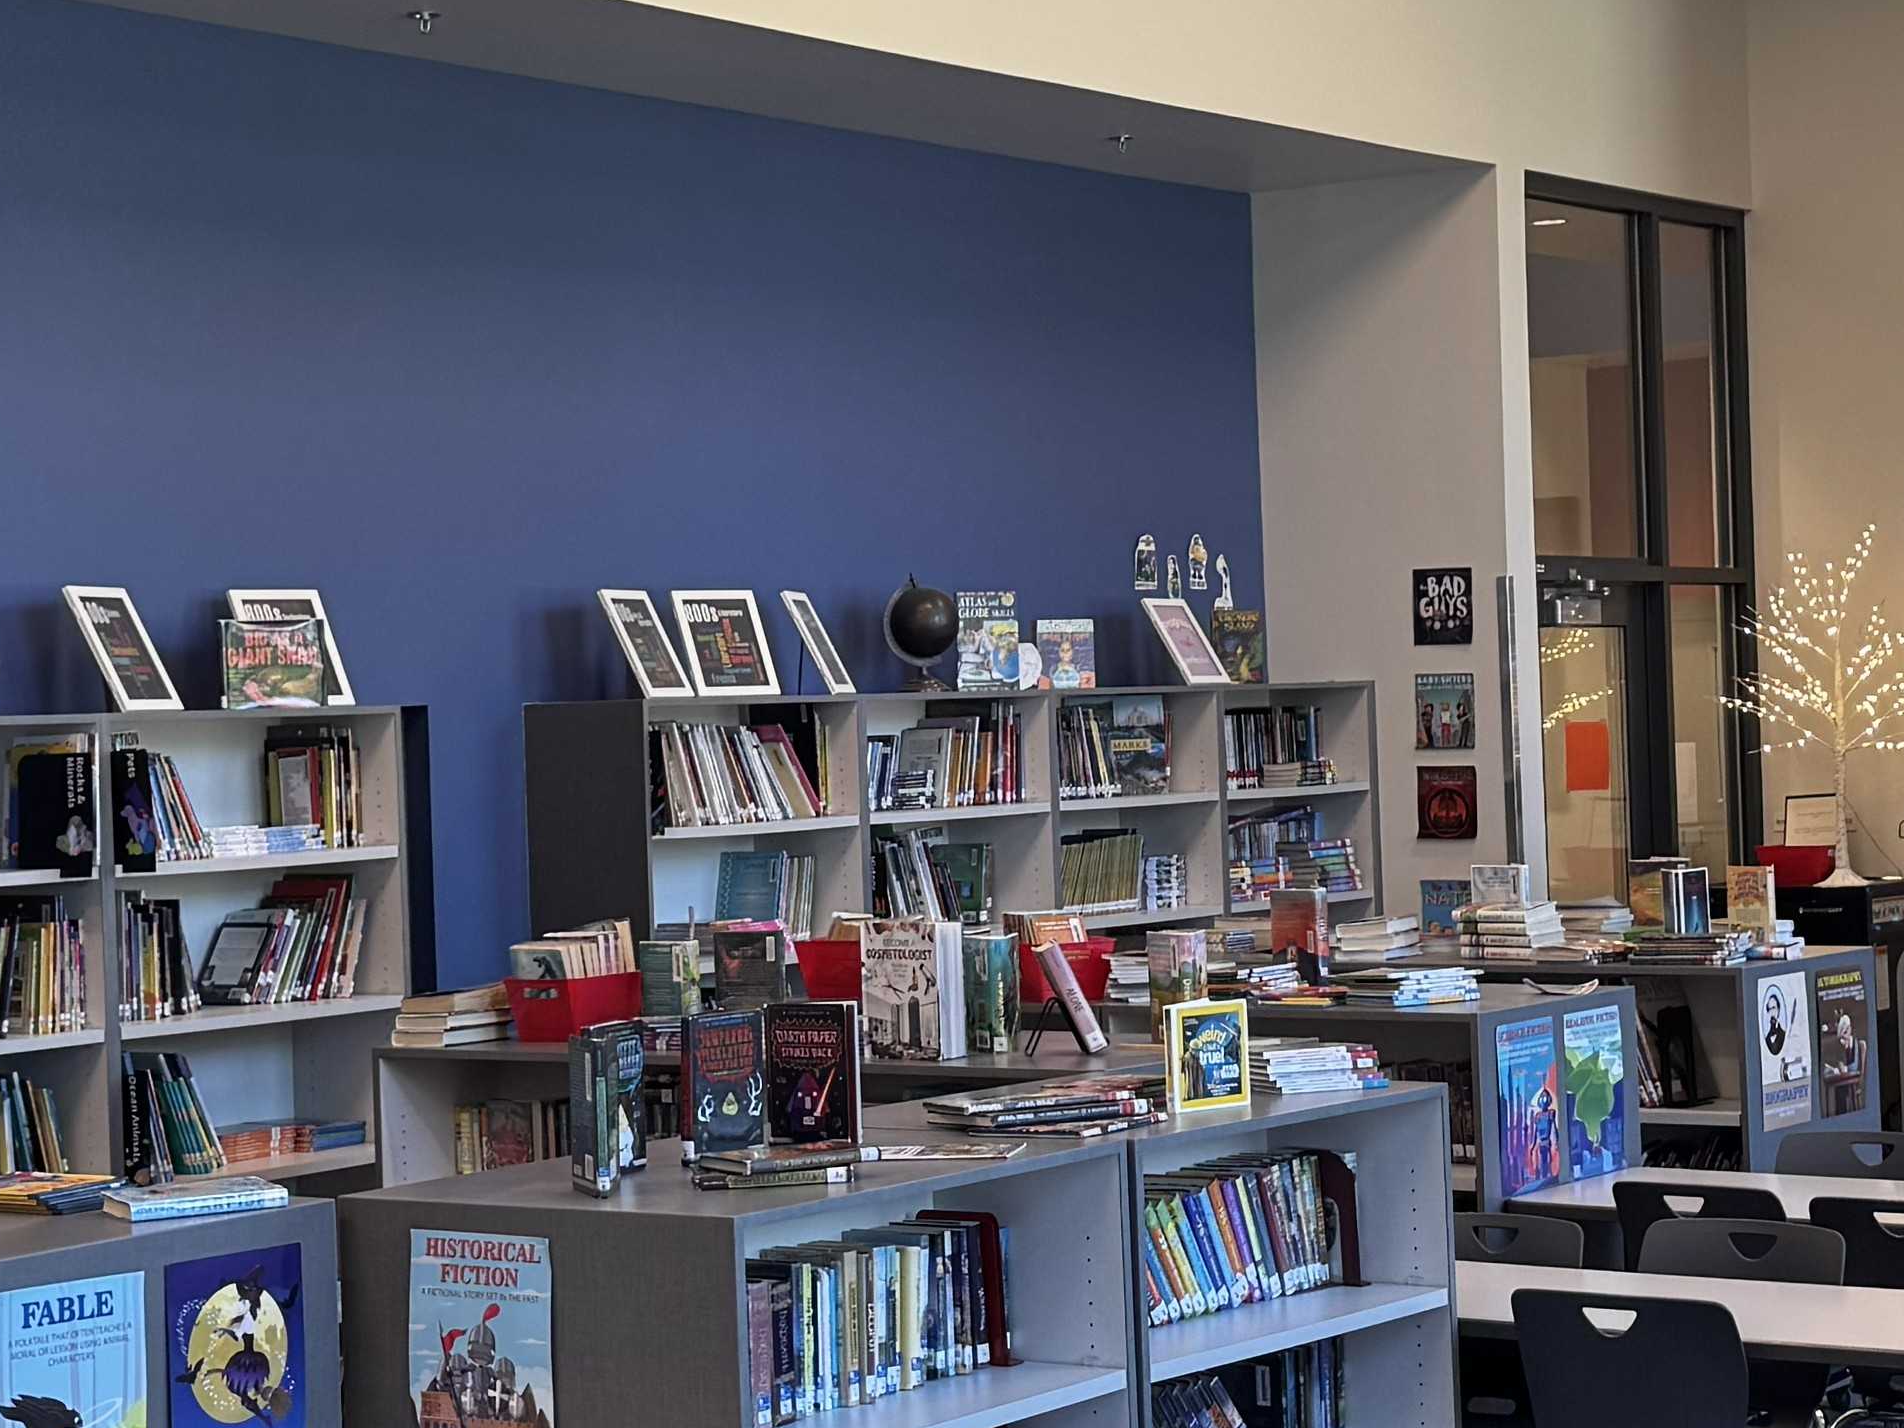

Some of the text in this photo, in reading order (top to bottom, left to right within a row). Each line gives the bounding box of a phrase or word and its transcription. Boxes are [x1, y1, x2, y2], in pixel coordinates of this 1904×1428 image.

[1427, 576, 1466, 599] BAD
[957, 606, 989, 619] GLOBE
[1419, 597, 1468, 618] GUYS
[227, 647, 272, 668] GIANT
[76, 756, 86, 791] Rocks
[126, 752, 136, 779] Pets
[66, 756, 76, 809] Minerals
[1199, 1023, 1233, 1046] weird
[131, 1114, 143, 1163] Animals
[424, 1236, 542, 1264] HISTORICAL
[439, 1263, 520, 1288] FICTION
[21, 1290, 114, 1330] FABLE
